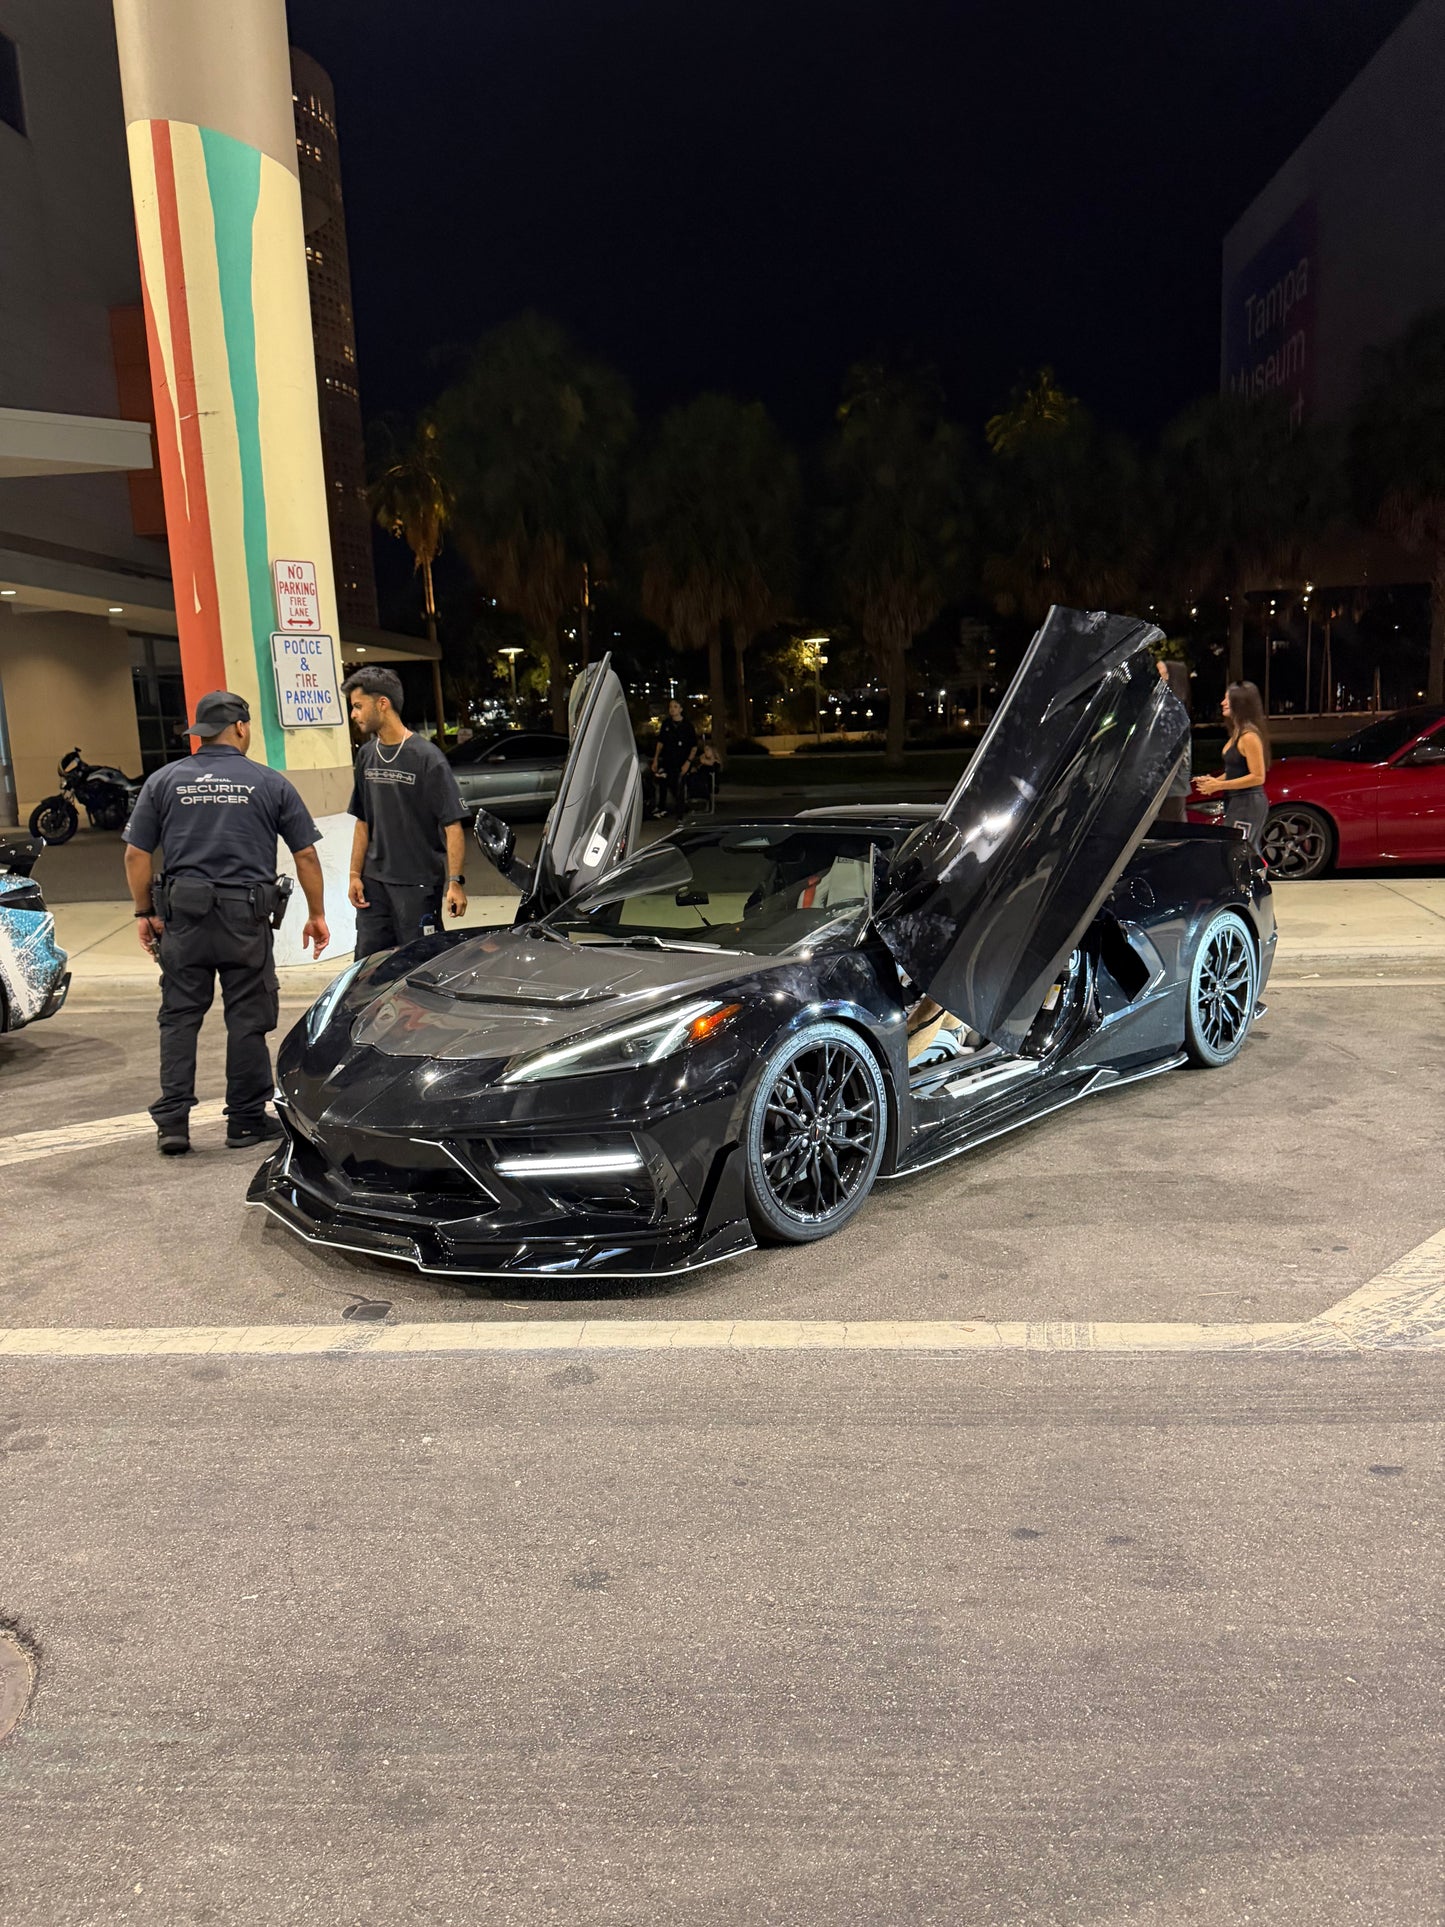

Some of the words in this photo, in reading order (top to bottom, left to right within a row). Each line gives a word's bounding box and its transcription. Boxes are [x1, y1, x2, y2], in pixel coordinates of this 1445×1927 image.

[1245, 257, 1309, 344] Tampa
[288, 566, 303, 580] NO
[279, 581, 316, 596] PARKING
[290, 597, 307, 606] FIRE
[289, 607, 309, 617] LANE
[284, 640, 322, 655] POLICE
[300, 657, 310, 671] &
[295, 673, 319, 688] FIRE
[286, 690, 332, 704] PARKING
[296, 707, 324, 722] ONLY
[176, 784, 256, 795] SECURITY
[180, 795, 249, 805] OFFICER
